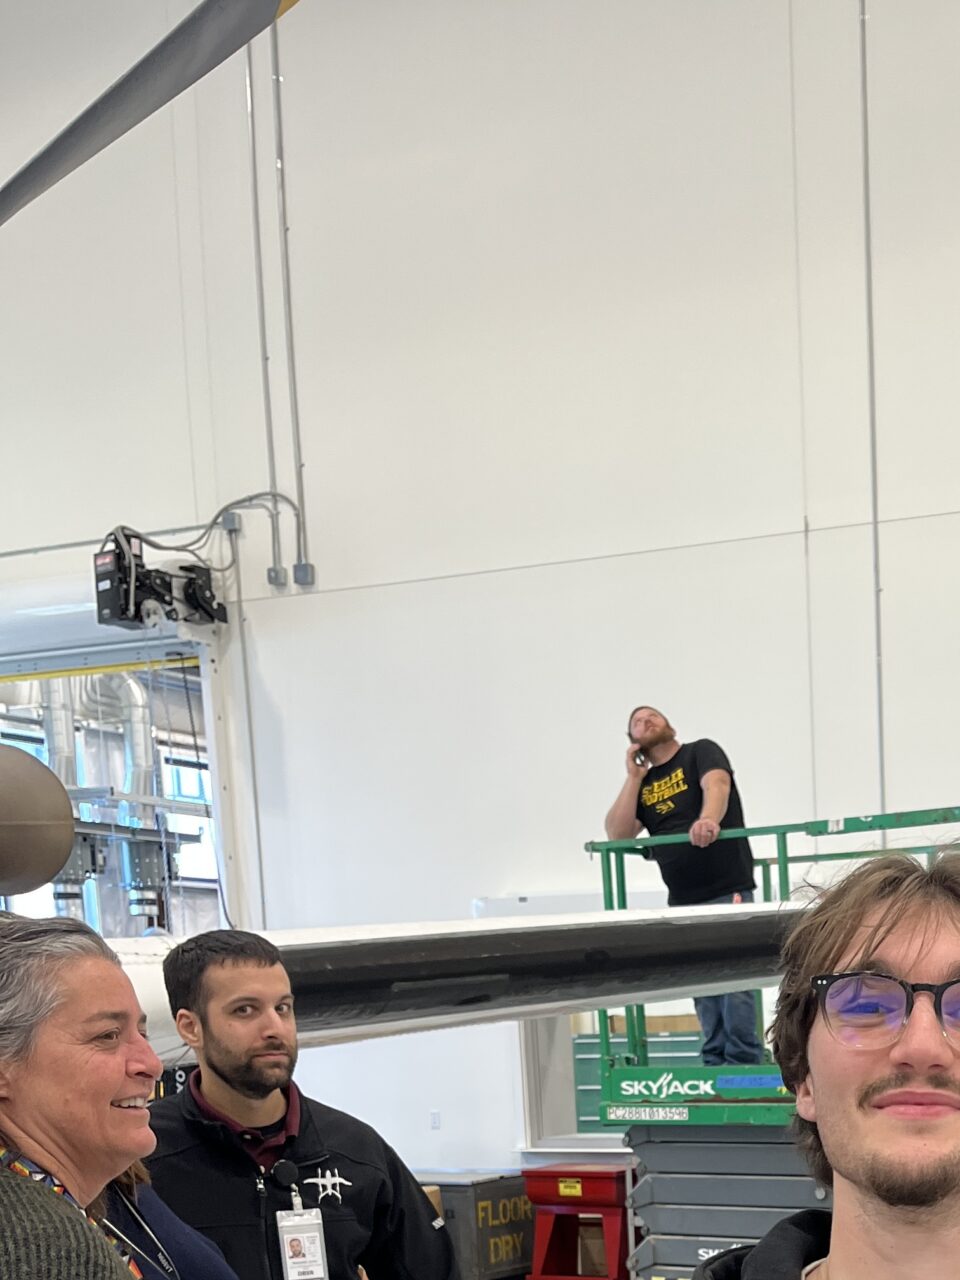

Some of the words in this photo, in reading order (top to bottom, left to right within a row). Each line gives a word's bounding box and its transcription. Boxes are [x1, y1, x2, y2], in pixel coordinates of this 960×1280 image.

[620, 1072, 715, 1099] SKYJACK
[478, 1193, 534, 1230] FLOOR
[489, 1231, 524, 1265] DRY
